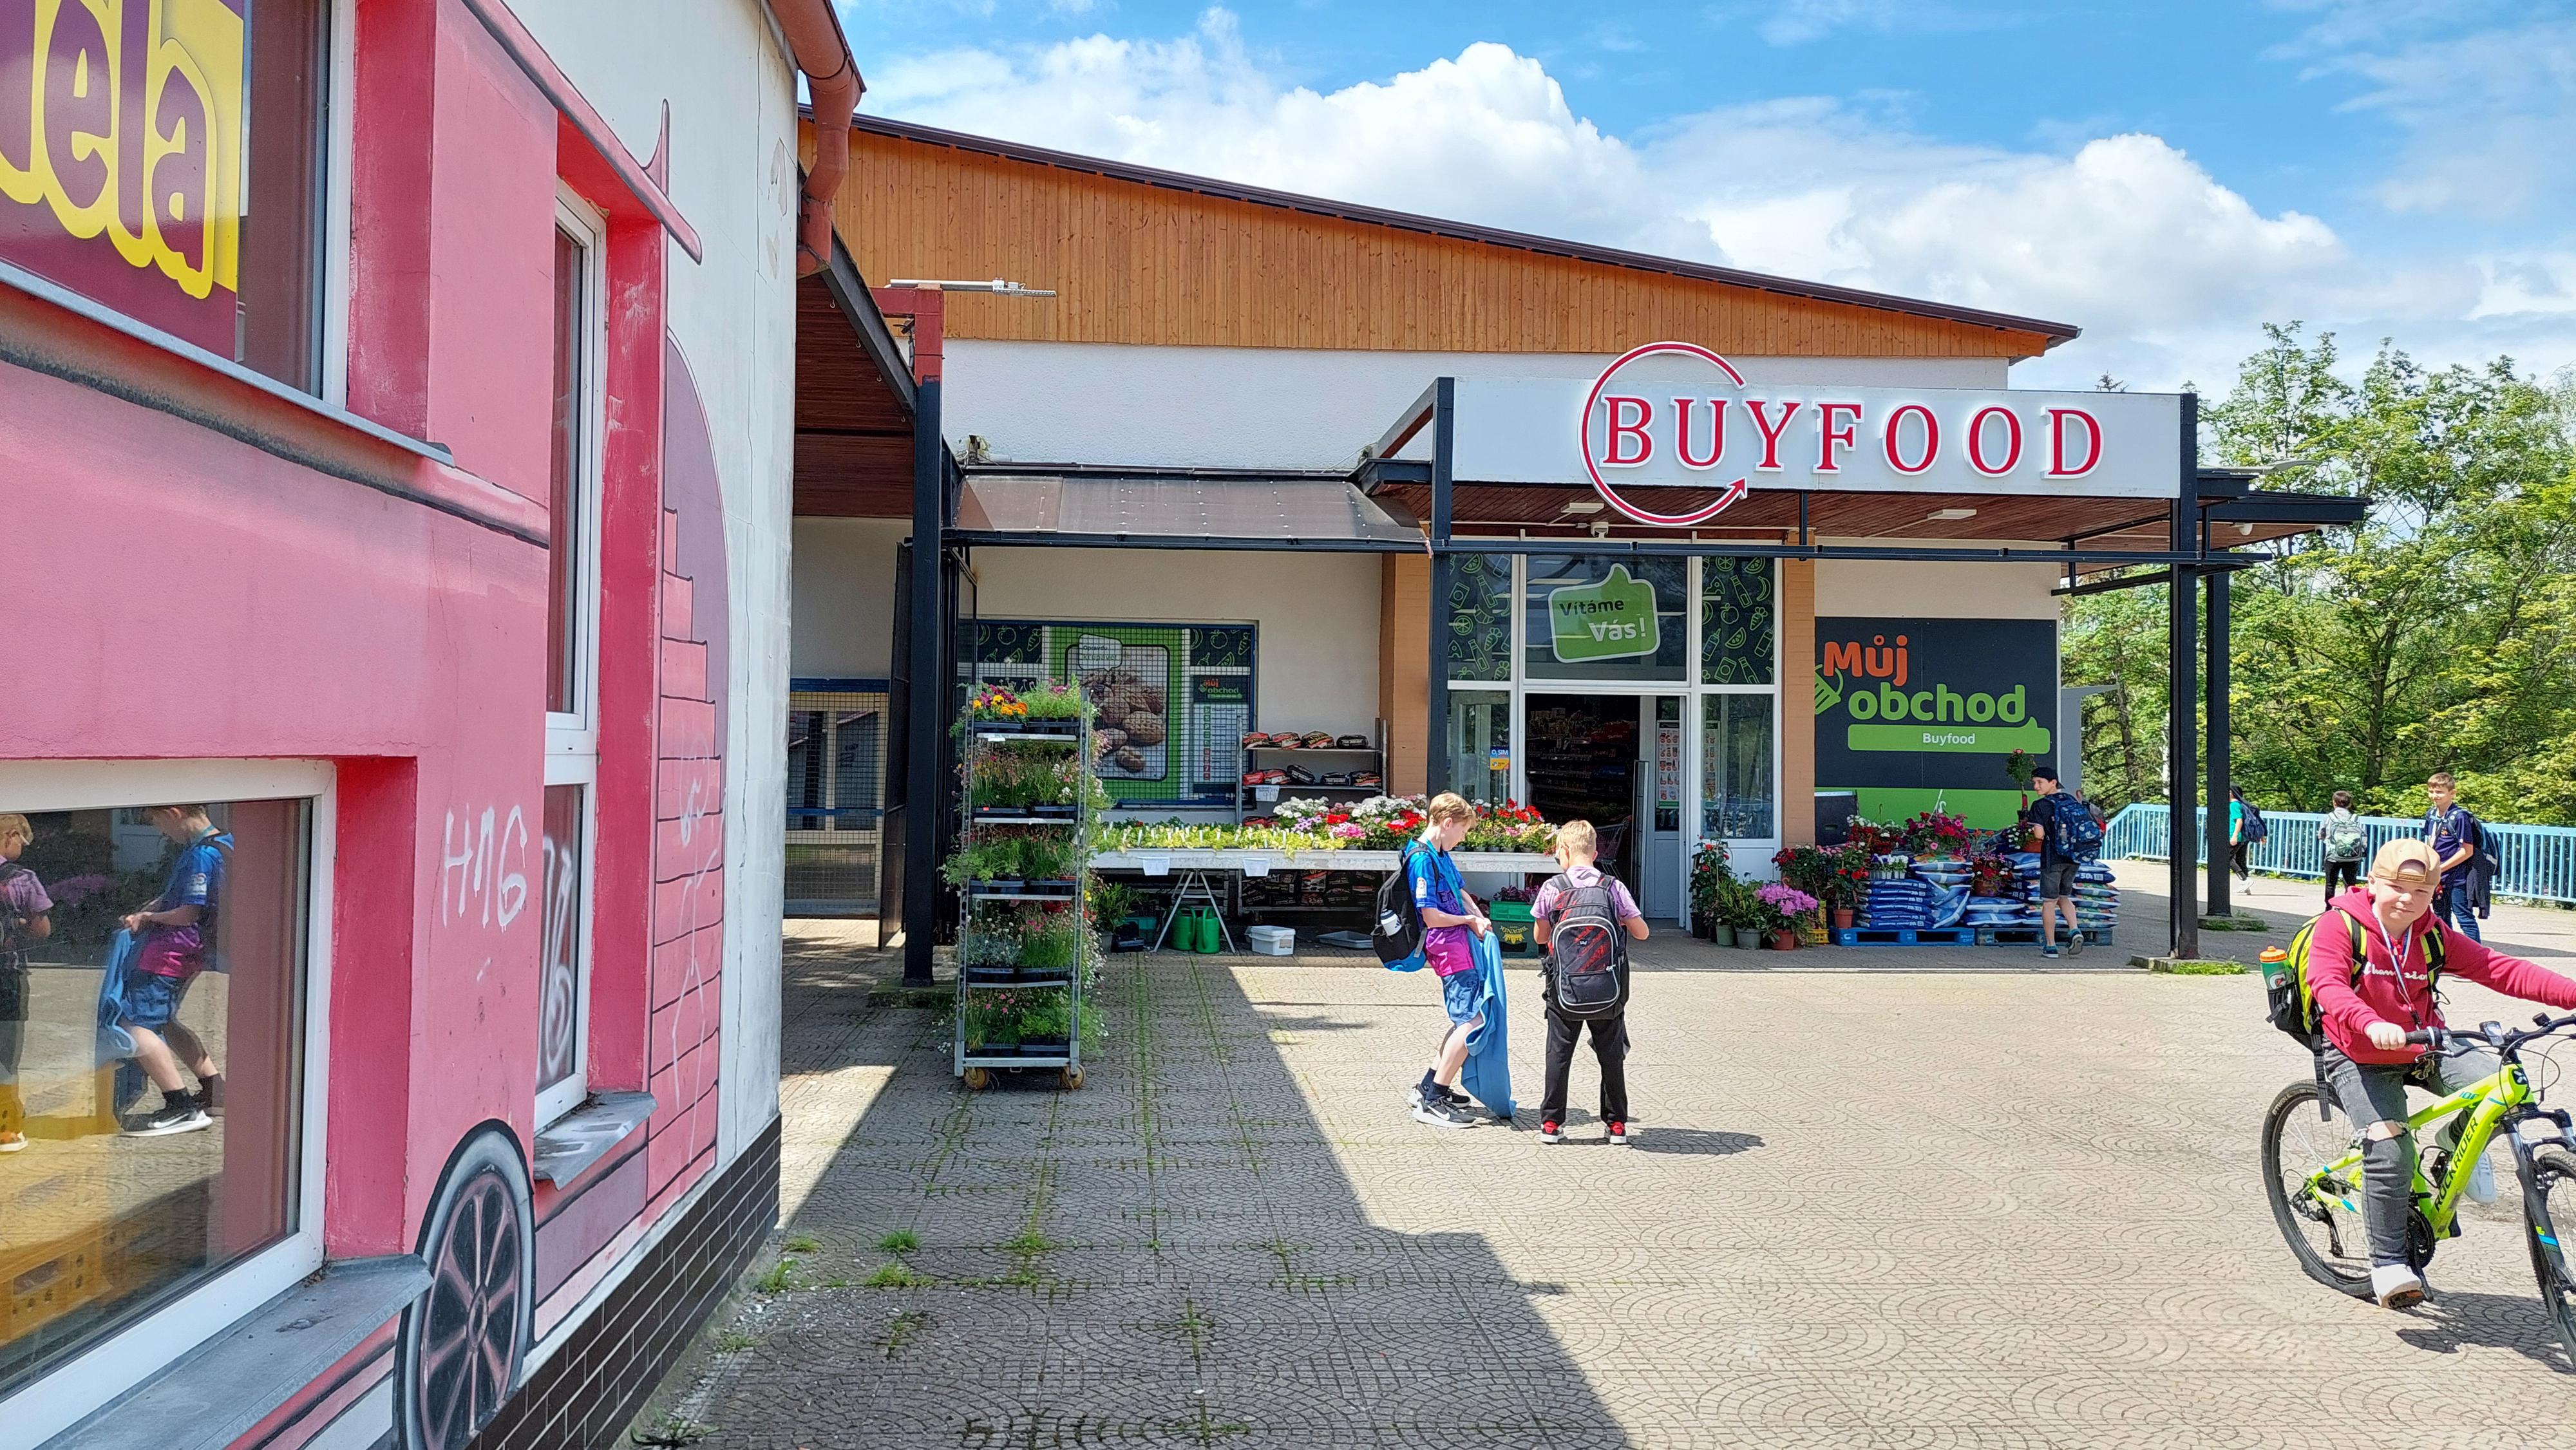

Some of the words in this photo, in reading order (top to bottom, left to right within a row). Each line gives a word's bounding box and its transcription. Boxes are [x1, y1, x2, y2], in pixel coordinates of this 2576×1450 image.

[1599, 393, 2105, 479] BUYFOOD
[1559, 597, 1625, 617] Vítáme
[1588, 617, 1647, 643] Vás!
[1823, 634, 1908, 687] Můj
[1848, 681, 2025, 723] obchod
[1922, 732, 1976, 746] Buyfood
[2434, 1116, 2479, 1211] ROCKRIDER
